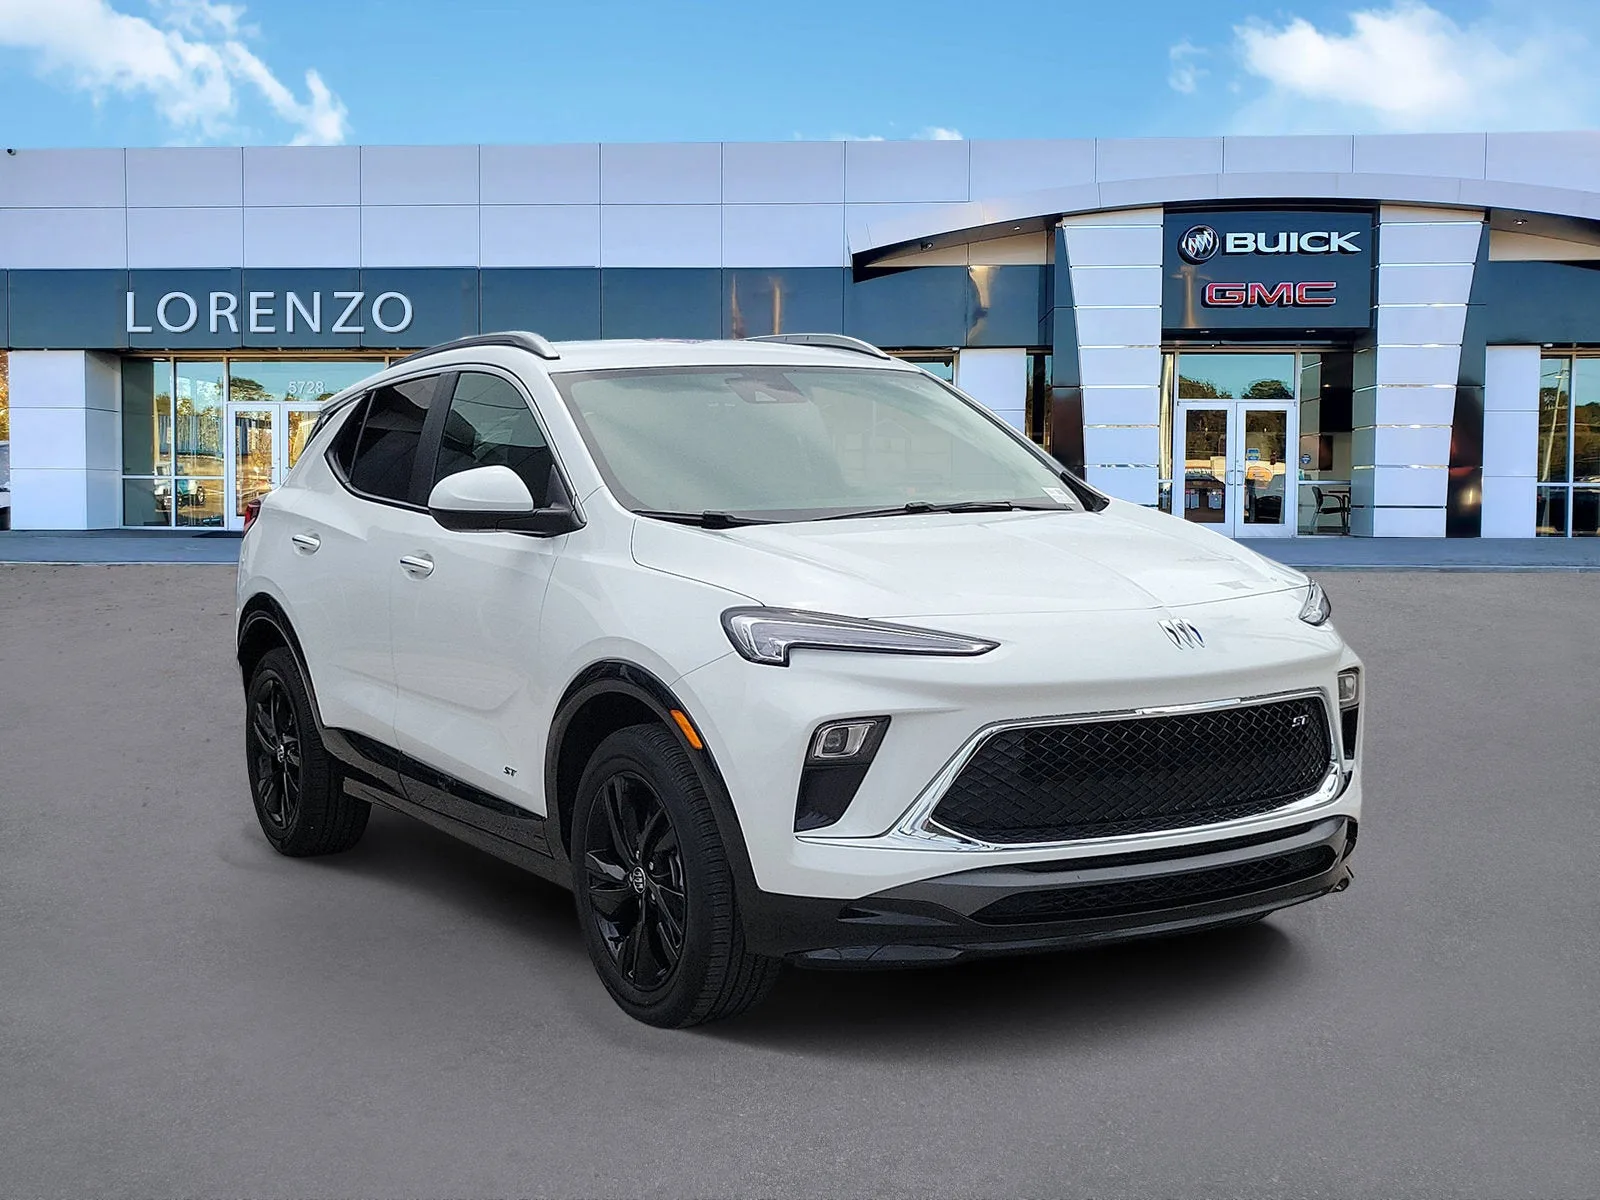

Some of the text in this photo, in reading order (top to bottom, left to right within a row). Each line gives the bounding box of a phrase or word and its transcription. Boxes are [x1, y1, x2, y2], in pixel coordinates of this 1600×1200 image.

[1226, 231, 1362, 252] BUICK
[1206, 282, 1337, 305] GMC
[126, 291, 413, 333] LORENZO
[288, 381, 325, 394] 5728
[1291, 714, 1309, 728] ST
[503, 766, 518, 777] ST
